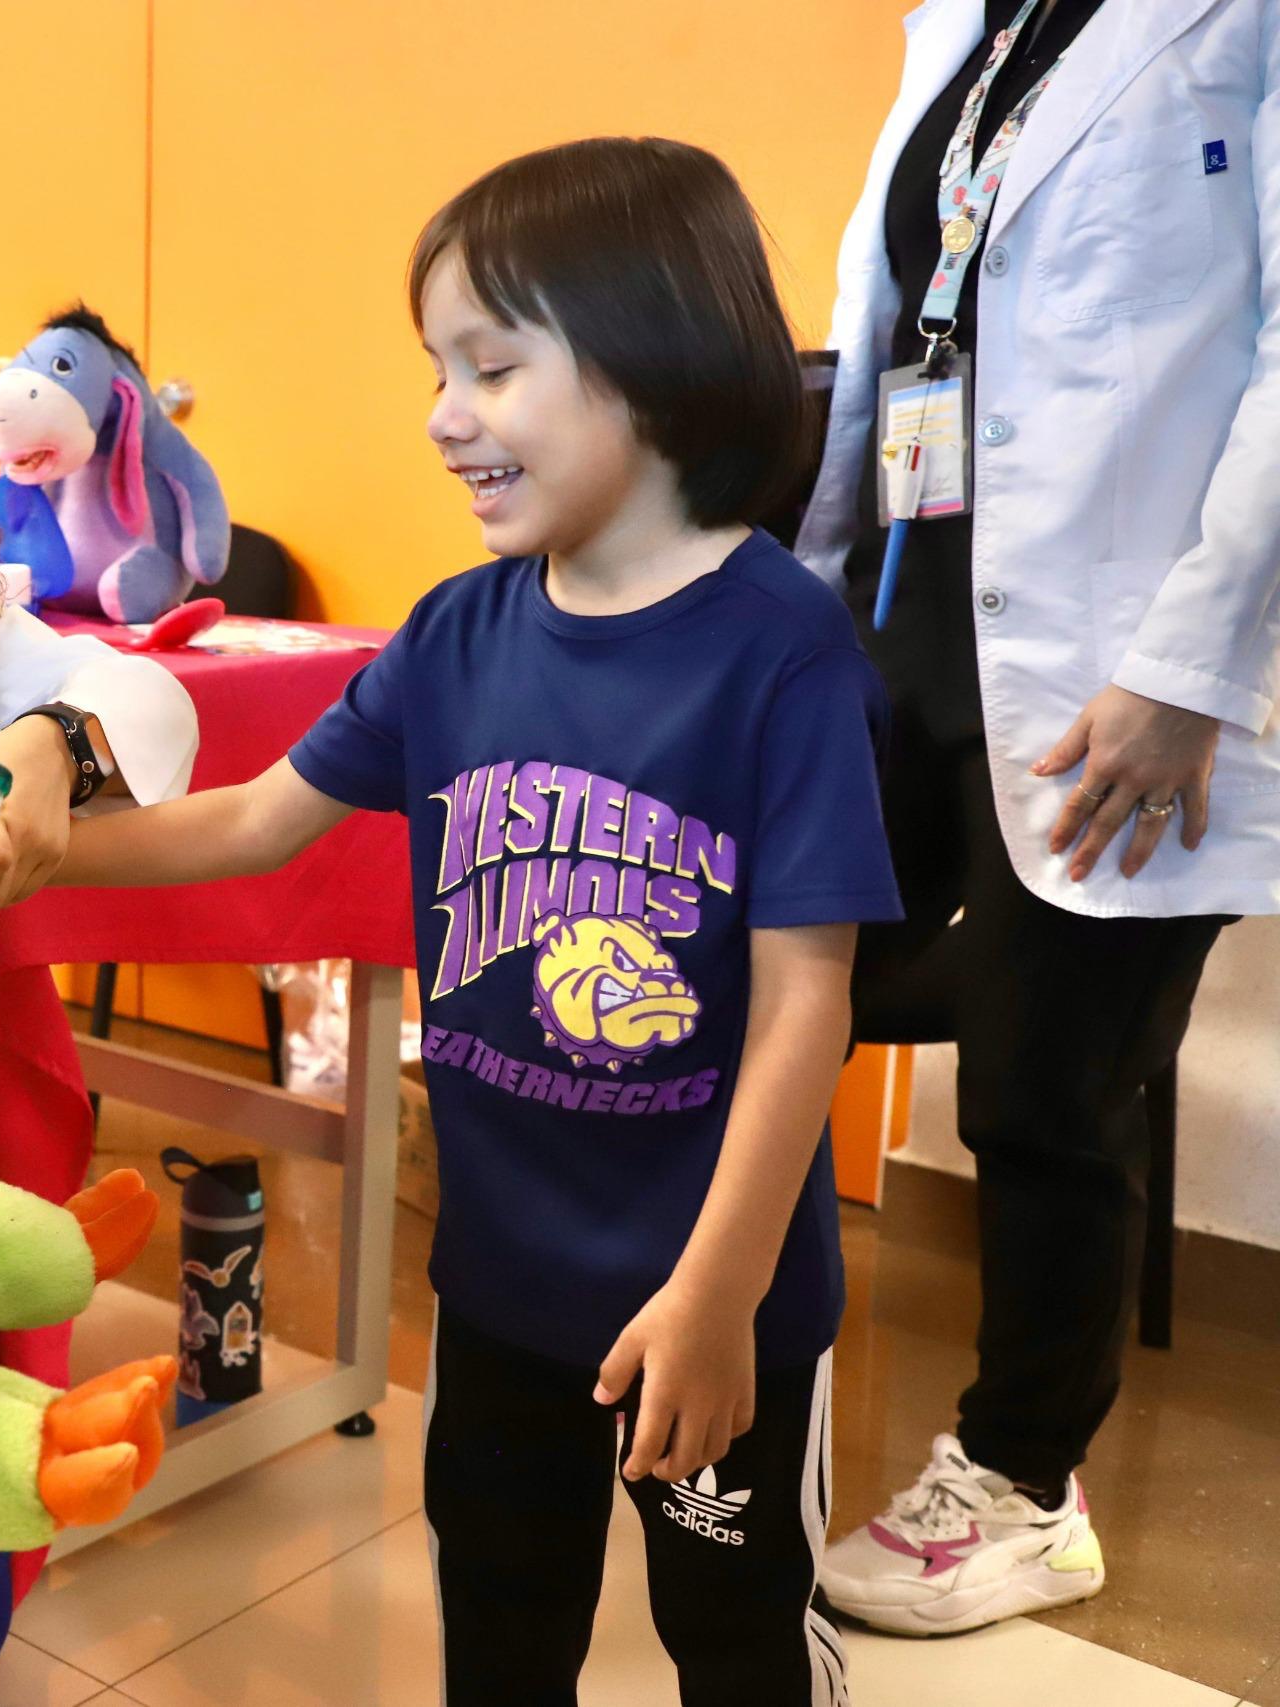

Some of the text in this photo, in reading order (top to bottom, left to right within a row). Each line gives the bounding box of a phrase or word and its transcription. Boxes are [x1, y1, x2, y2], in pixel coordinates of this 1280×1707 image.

[427, 760, 737, 895] WESTERN
[430, 857, 702, 1002] ILLINOIS
[662, 1501, 745, 1546] adidas
